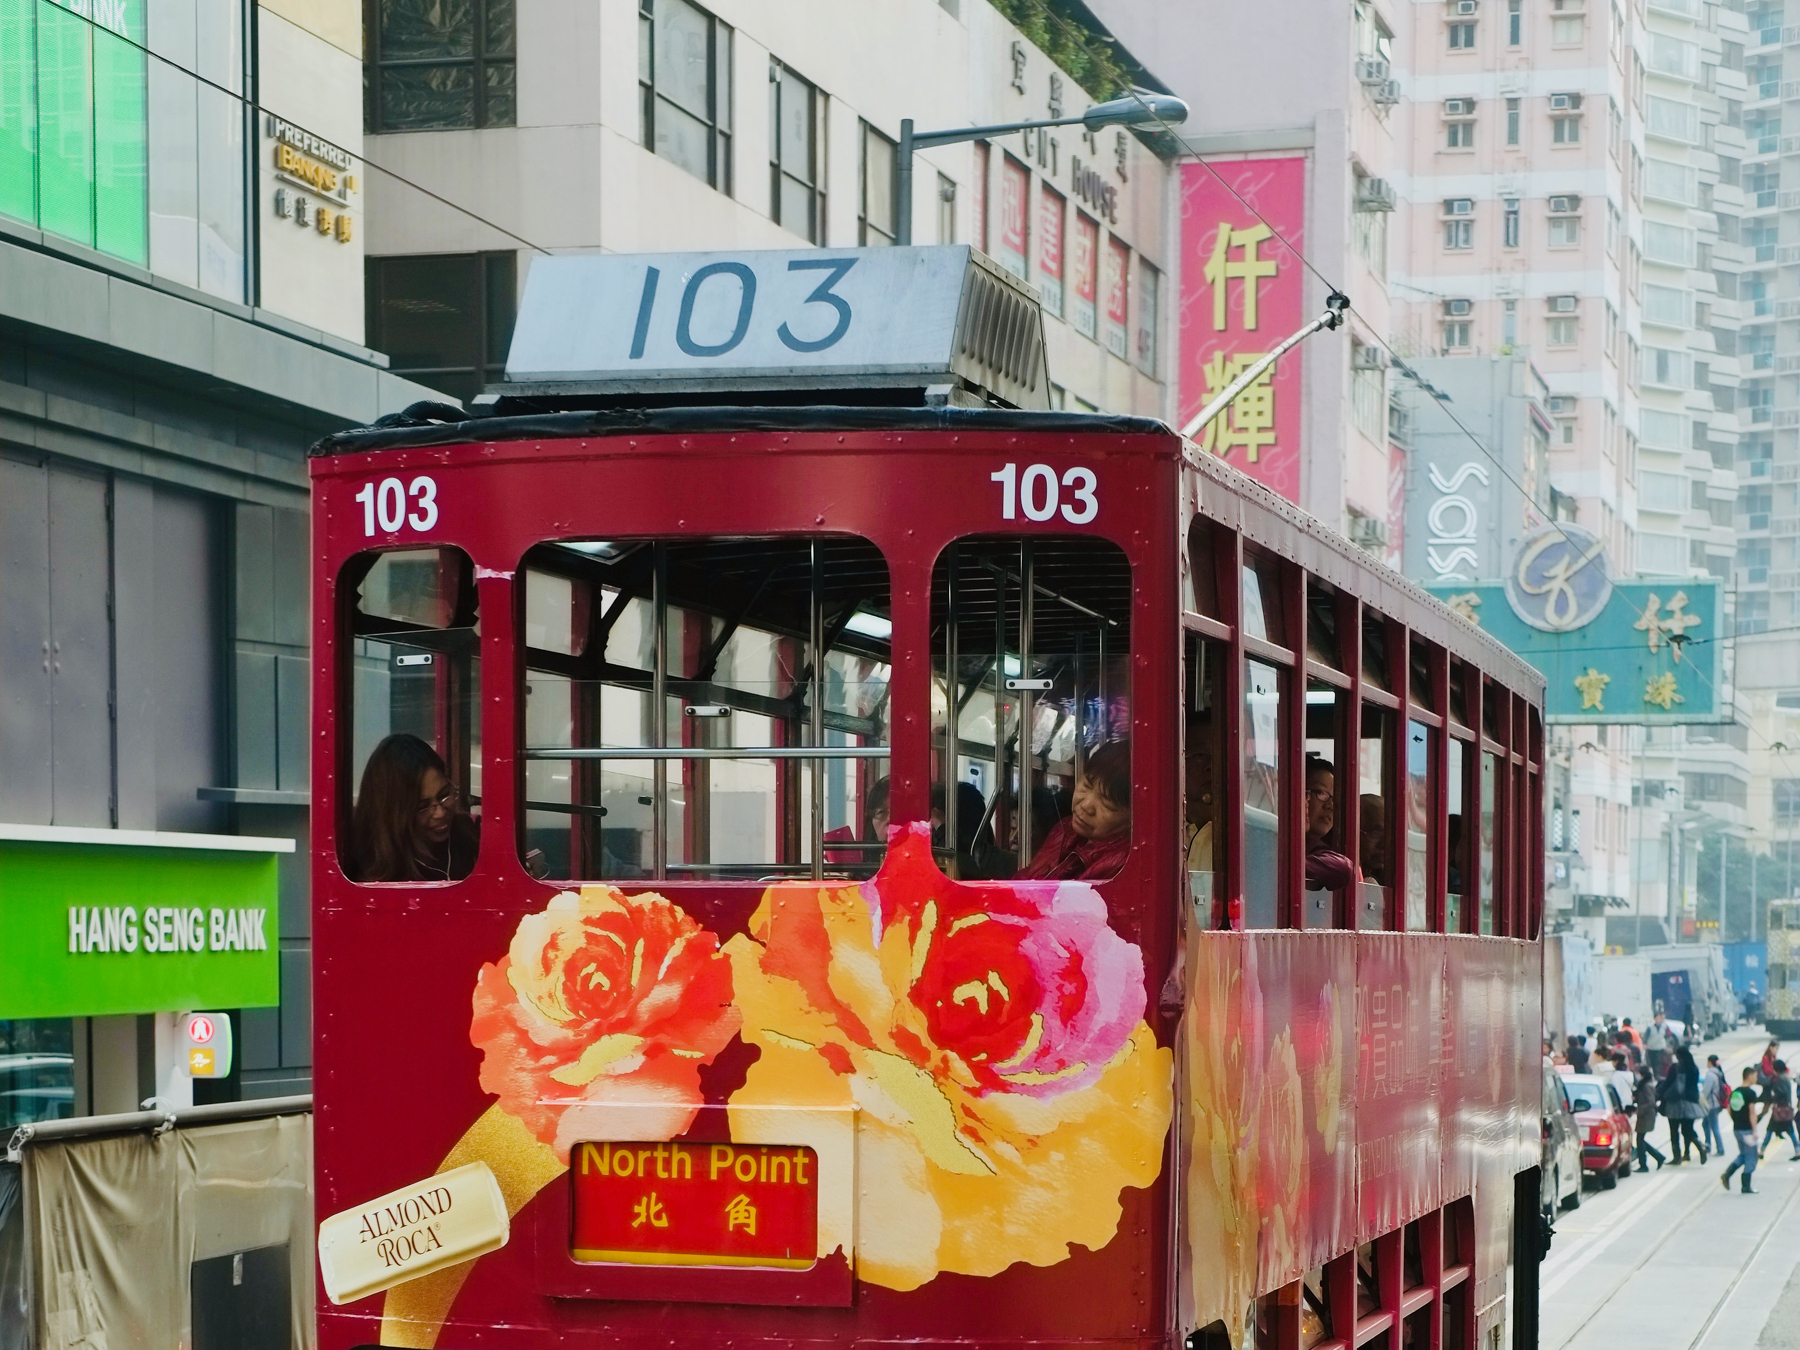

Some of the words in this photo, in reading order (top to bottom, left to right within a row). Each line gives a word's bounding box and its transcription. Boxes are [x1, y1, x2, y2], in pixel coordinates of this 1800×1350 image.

[271, 117, 352, 171] PREFERRED
[276, 143, 338, 192] BANKING
[1072, 154, 1118, 225] HOUSE
[629, 257, 860, 360] 103
[355, 475, 439, 537] 103
[990, 462, 1099, 525] 103
[68, 906, 138, 953] HANG
[143, 906, 205, 953] SENG
[209, 908, 267, 952] BANK
[581, 1142, 692, 1180] North
[710, 1144, 810, 1185] Point
[359, 1187, 452, 1243] ALMOND
[631, 1191, 758, 1236] 北角
